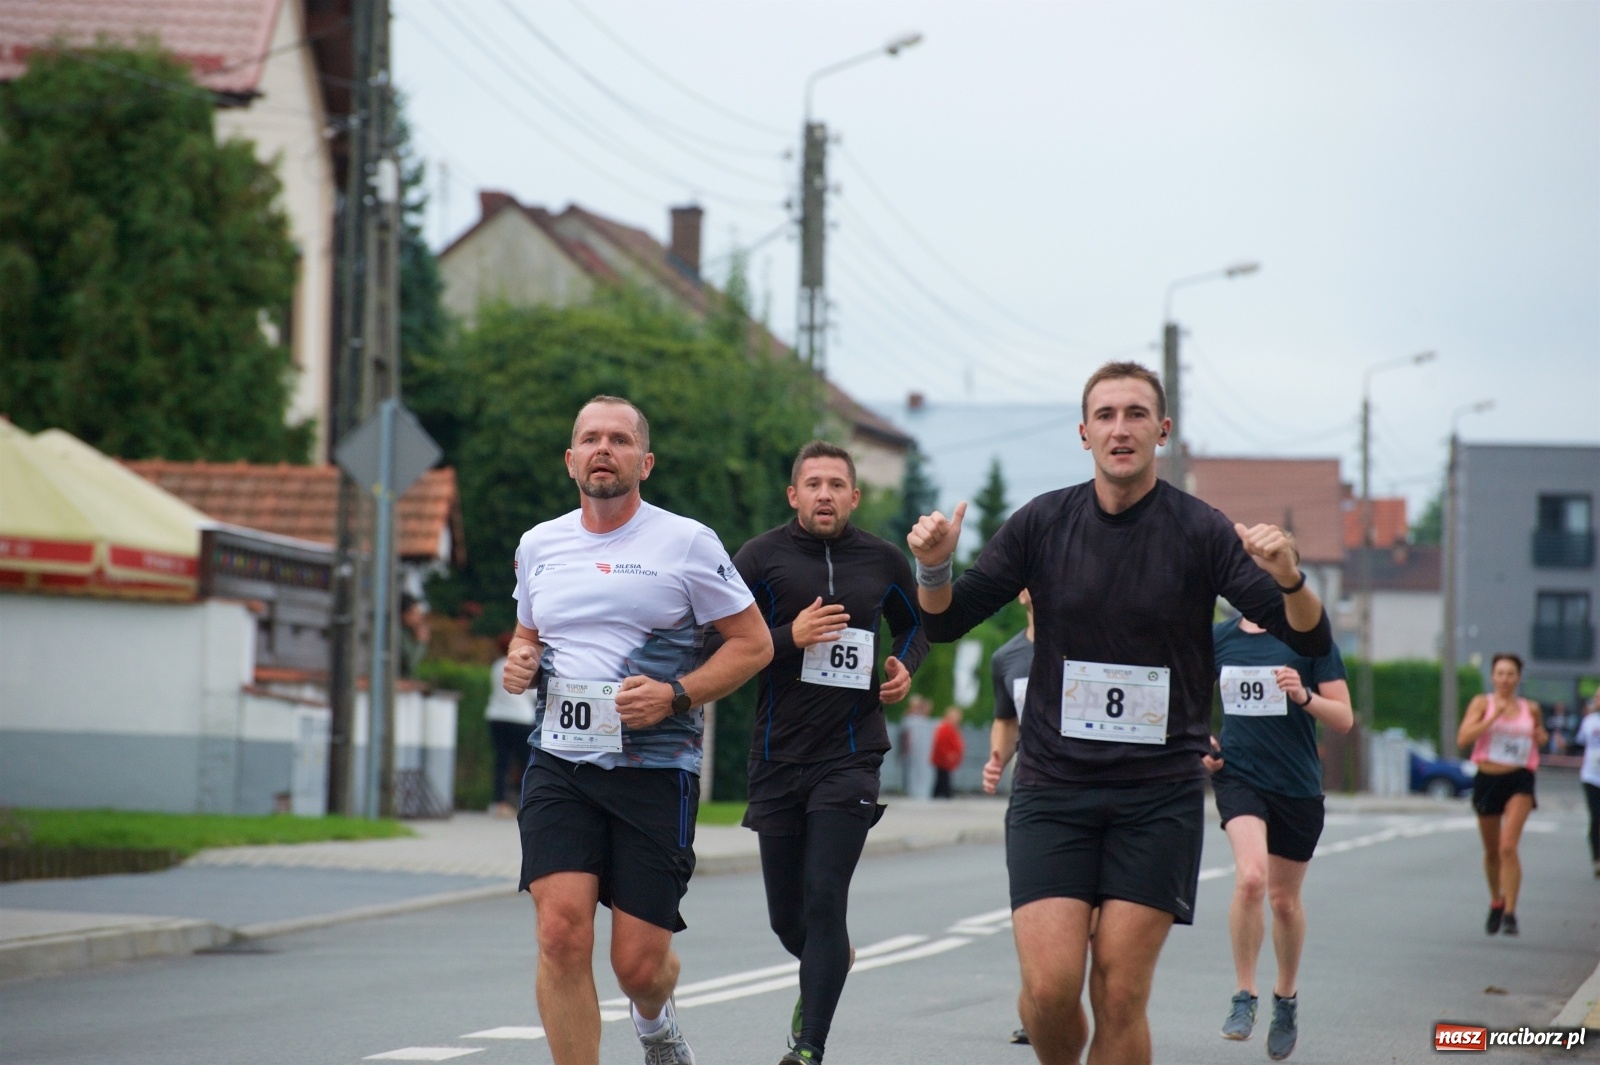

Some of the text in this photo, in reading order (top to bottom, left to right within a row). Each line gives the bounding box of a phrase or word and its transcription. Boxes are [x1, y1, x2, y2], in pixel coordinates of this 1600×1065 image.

[613, 569, 658, 577] MARATHON
[830, 644, 858, 670] 65
[1106, 687, 1125, 718] 8
[1240, 681, 1264, 701] 99
[560, 700, 591, 731] 80
